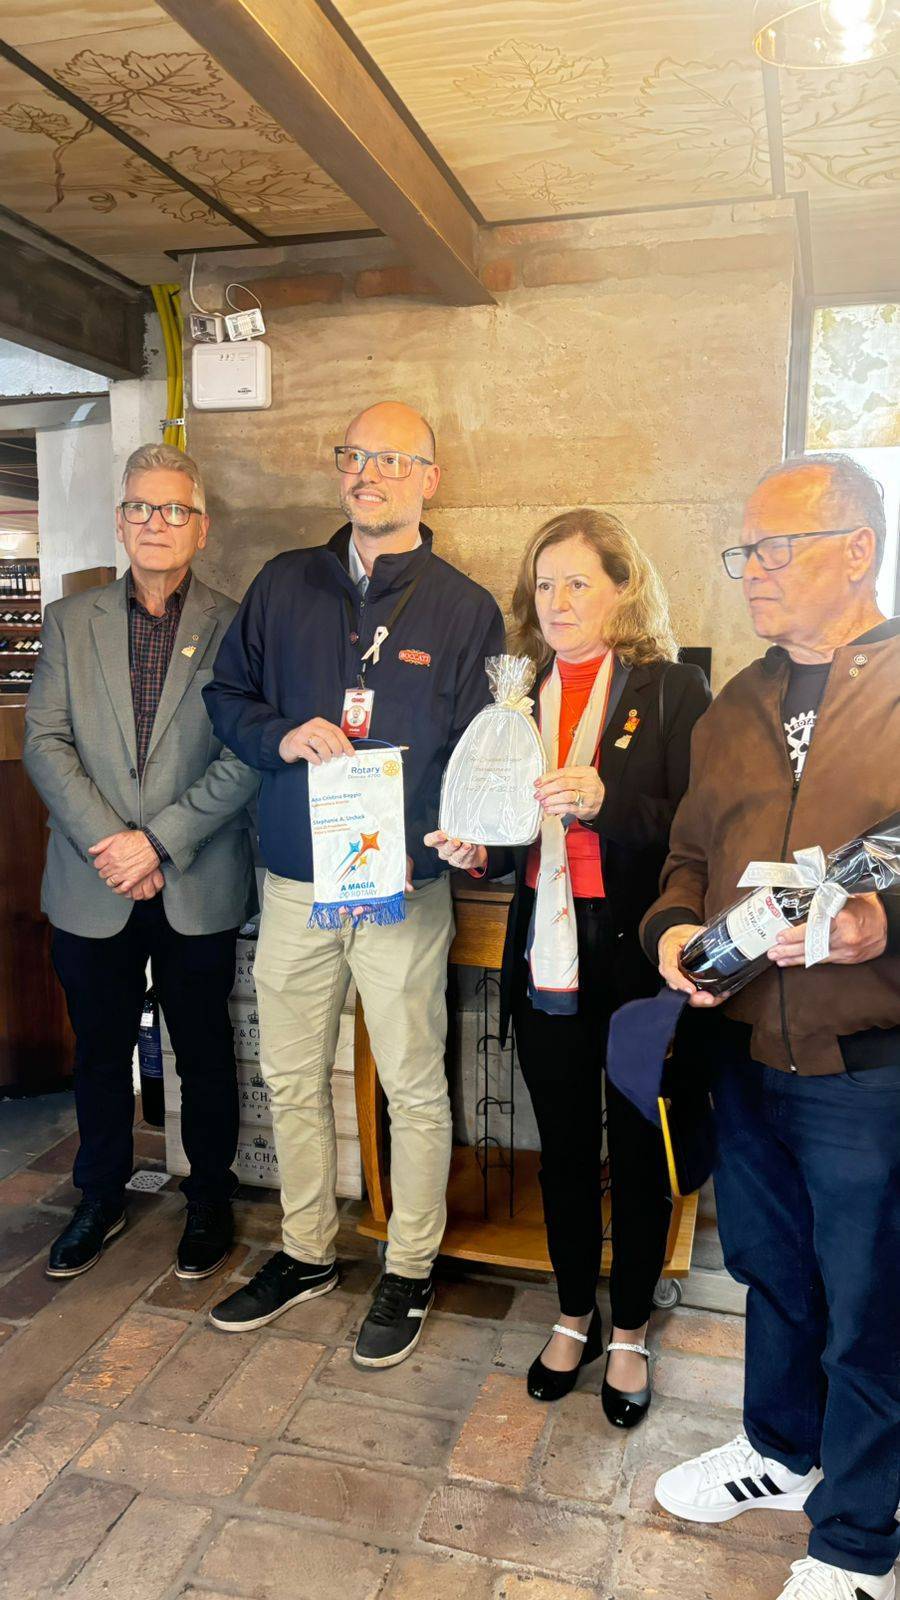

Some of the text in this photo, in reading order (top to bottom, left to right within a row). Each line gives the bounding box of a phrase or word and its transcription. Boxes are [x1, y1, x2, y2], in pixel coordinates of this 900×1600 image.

[351, 766, 380, 774] Rotary
[341, 881, 375, 892] A MAGIA
[351, 889, 377, 897] ROTARY
[239, 1028, 246, 1038] &
[242, 1090, 271, 1102] & CH
[245, 1152, 251, 1161] &
[254, 1151, 278, 1164] CHA
